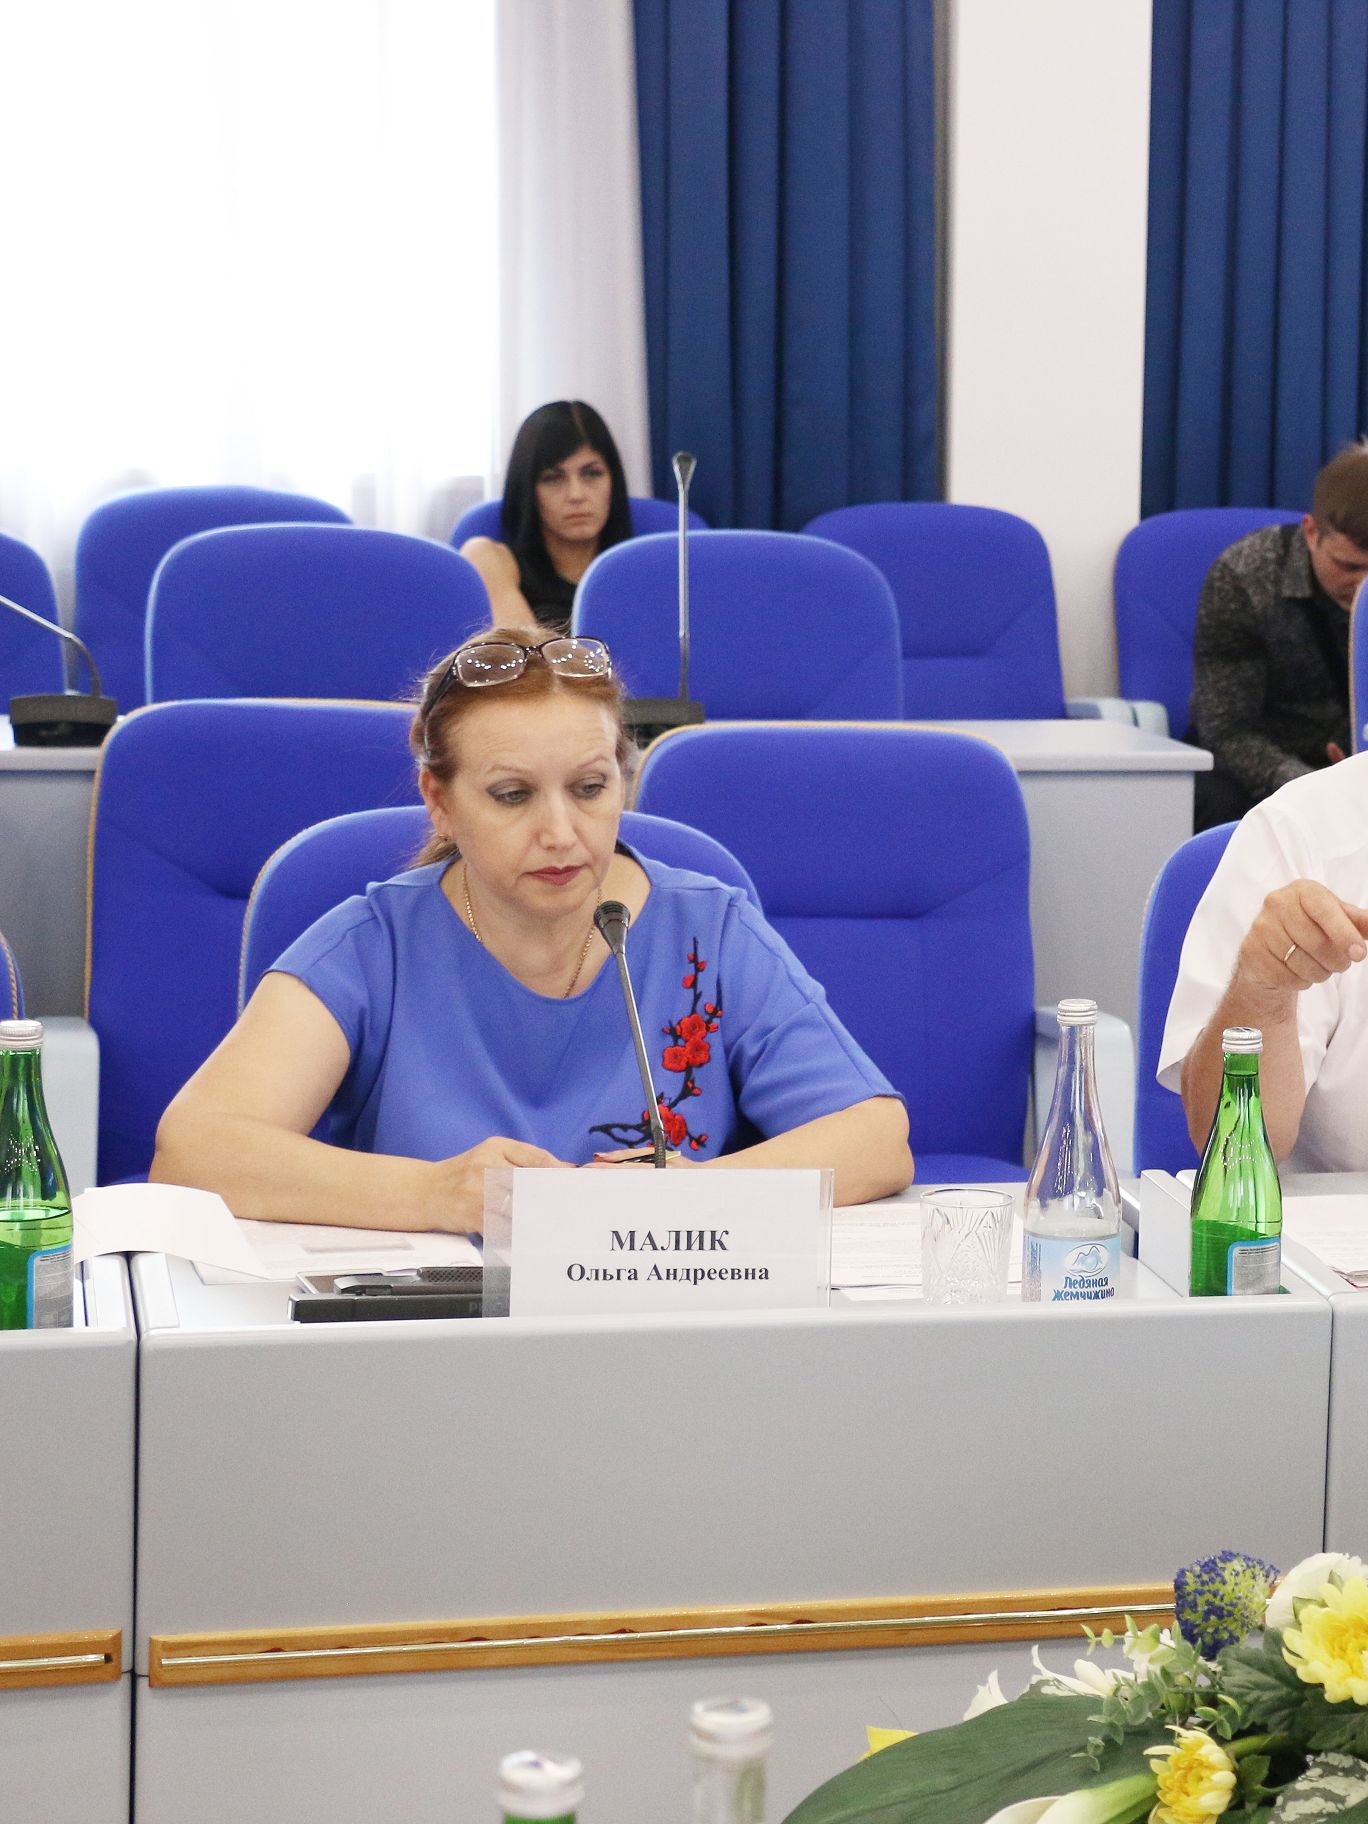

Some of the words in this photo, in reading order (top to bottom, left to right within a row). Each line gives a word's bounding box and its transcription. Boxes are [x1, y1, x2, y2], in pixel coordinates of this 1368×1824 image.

[610, 1230, 730, 1251] МАЛИК
[566, 1263, 639, 1282] Ольга
[647, 1263, 770, 1285] Андреевна
[1064, 1274, 1109, 1289] Ледяная
